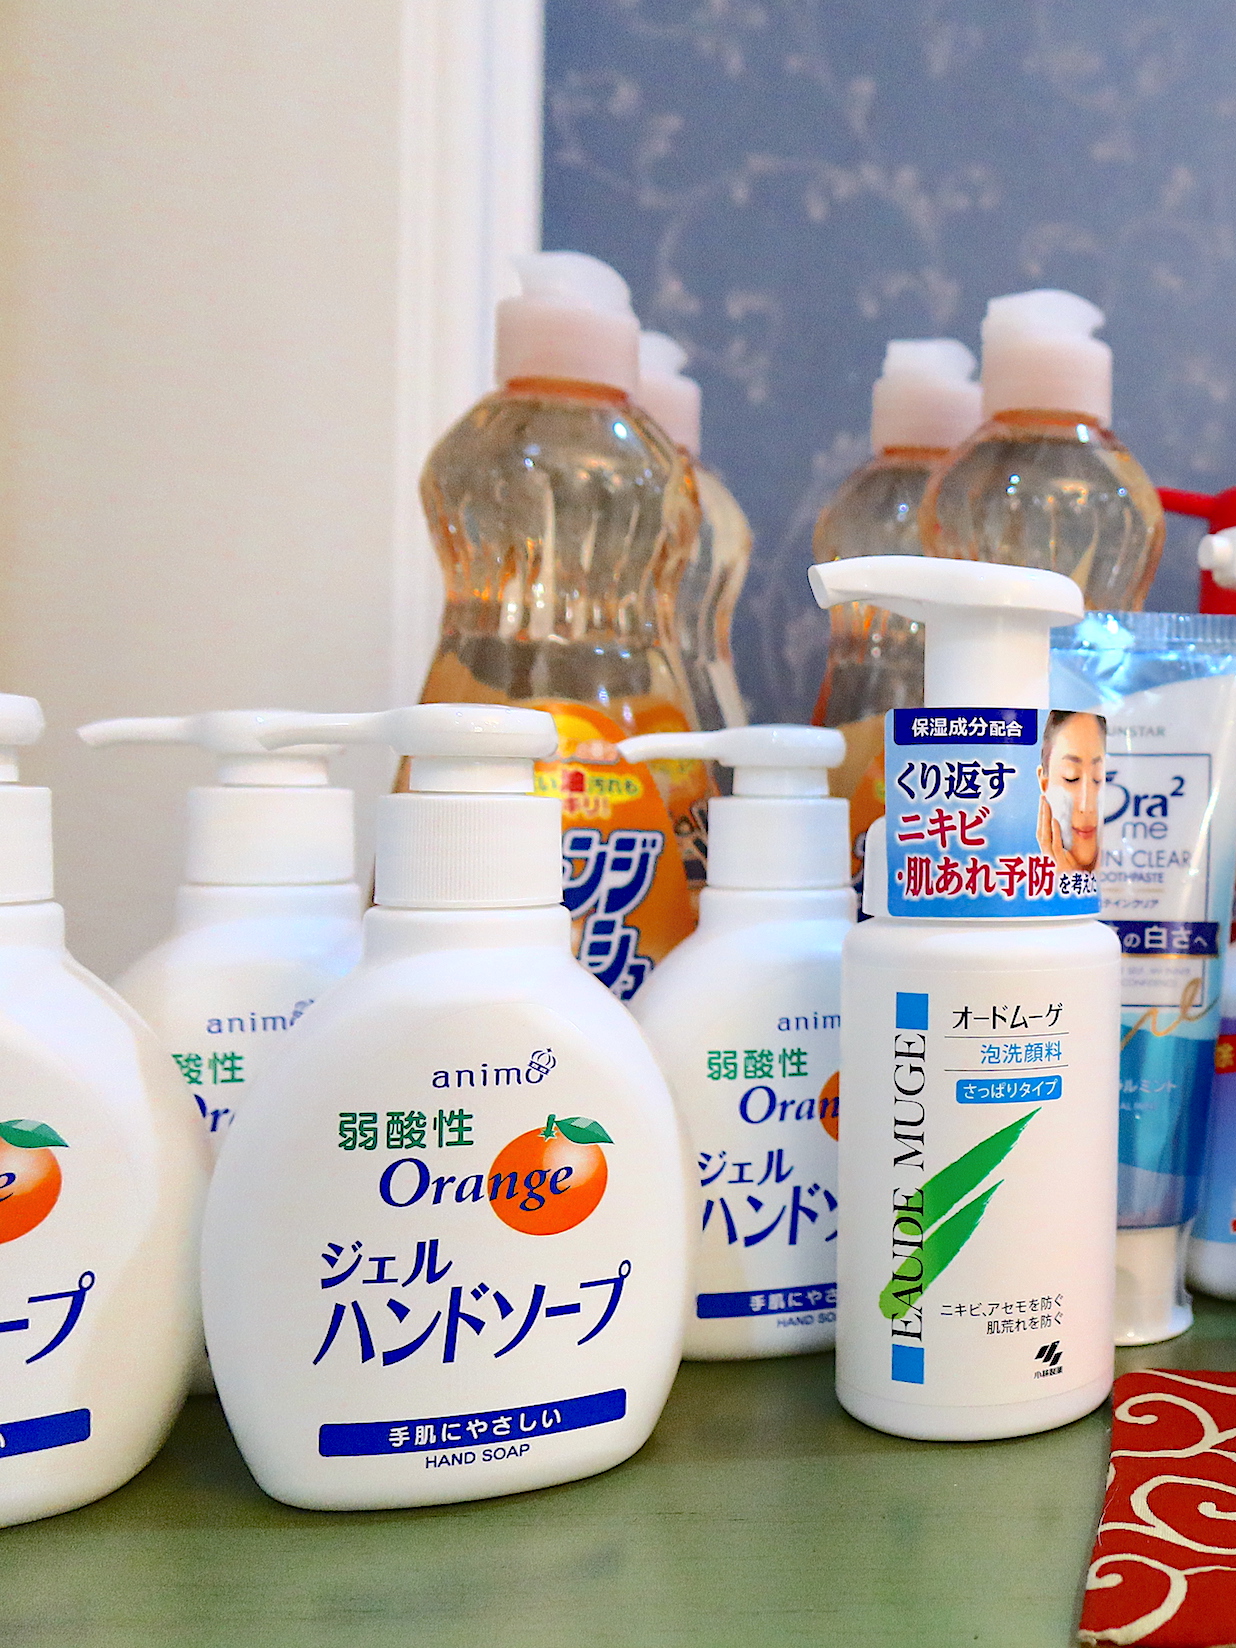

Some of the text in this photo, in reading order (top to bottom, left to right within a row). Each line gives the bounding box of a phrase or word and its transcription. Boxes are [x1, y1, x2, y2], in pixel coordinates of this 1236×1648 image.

[911, 717, 1024, 738] 保湿成分配合
[897, 760, 1016, 800] くり返す
[897, 806, 990, 848] ニキビ
[1121, 820, 1169, 840] me
[1112, 924, 1209, 950] の白さへ
[952, 1002, 1063, 1030] オードムーゲ
[706, 1047, 809, 1081] 弱酸性
[980, 1040, 1063, 1065] 泡洗顔料
[893, 1033, 926, 1172] MUGE
[962, 1078, 1059, 1100] さっぱりタイプ
[338, 1108, 474, 1151] 弱酸性
[379, 1157, 574, 1212] Orange
[698, 1148, 795, 1188] ジェル
[320, 1238, 453, 1290] ジェル
[312, 1259, 632, 1367] ハンドソープ
[940, 1293, 1064, 1318] ニキビ、アセモを防ぐ
[985, 1311, 1064, 1336] 肌荒れを防ぐ
[388, 1407, 562, 1448] 手肌にやさしい
[425, 1443, 531, 1469] HAND SOAP
